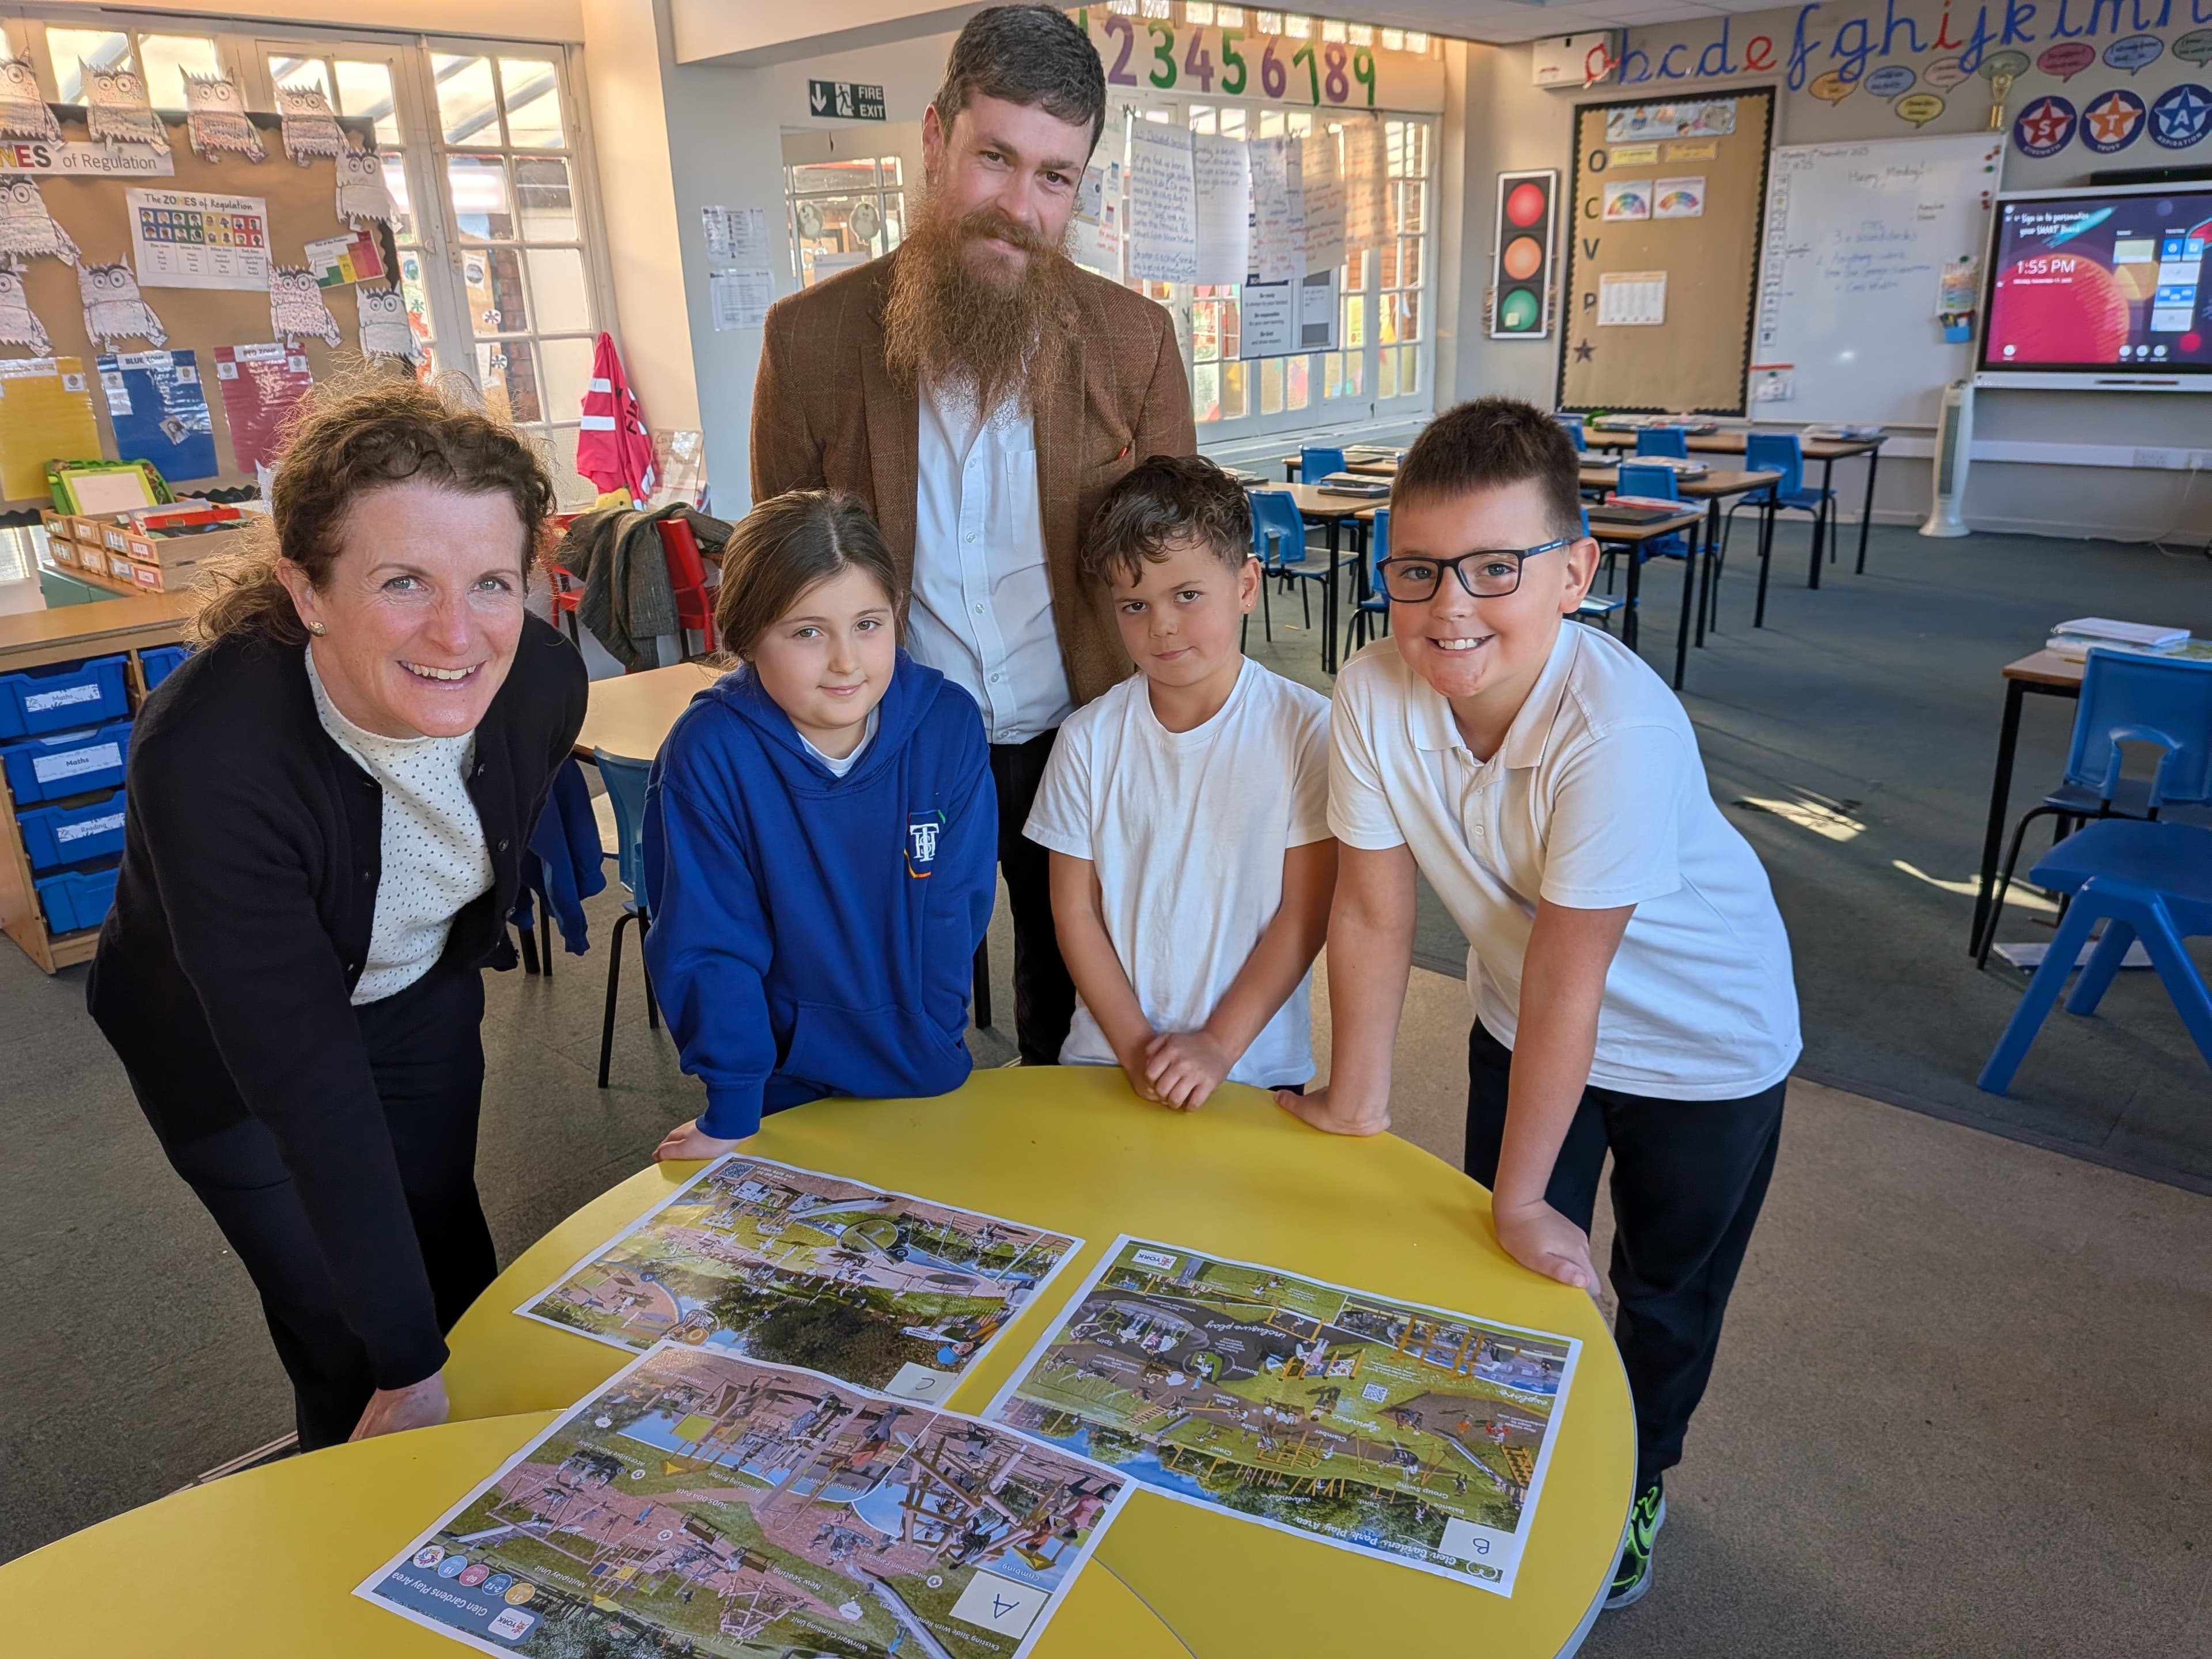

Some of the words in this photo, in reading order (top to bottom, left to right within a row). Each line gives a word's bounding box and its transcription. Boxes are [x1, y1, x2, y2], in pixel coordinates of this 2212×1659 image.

[1105, 15, 1137, 86] 2
[1148, 20, 1177, 89] 3
[1185, 26, 1214, 92] 4
[1222, 29, 1246, 94] 5
[1262, 32, 1287, 99] 6
[1293, 40, 1320, 107] 7
[1325, 42, 1349, 103] 8
[1354, 44, 1375, 106] 9
[858, 86, 882, 100] FIRE
[859, 104, 885, 118] EXIT
[2174, 109, 2190, 125] A
[2038, 120, 2050, 136] S
[2105, 115, 2119, 130] T
[2157, 132, 2203, 147] ASPIRATION
[62, 153, 77, 168] of
[81, 153, 157, 171] Regulation
[1588, 150, 1607, 173] O
[145, 194, 161, 203] The
[163, 195, 196, 206] ZONES
[199, 200, 207, 210] of
[211, 200, 253, 211] Regulation
[1585, 197, 1599, 220] C
[2022, 213, 2035, 225] Sign
[2036, 225, 2059, 235] SMART
[1583, 238, 1600, 261] V
[2017, 260, 2047, 274] 1:55
[2051, 259, 2075, 273] PM
[125, 356, 144, 365] BLUE
[52, 692, 74, 702] Maths
[66, 756, 89, 766] Maths
[81, 822, 107, 833] Reading
[1138, 1253, 1160, 1262] YORK
[1204, 1320, 1234, 1331] play
[1233, 1325, 1286, 1340] inclusive
[1097, 1338, 1114, 1346] Spin
[1233, 1365, 1259, 1376] Bounce
[668, 1372, 703, 1384] Horizontal
[1213, 1392, 1238, 1403] together
[1216, 1398, 1232, 1406] Rock
[1241, 1422, 1259, 1432] Slide
[1314, 1429, 1347, 1443] Clamber
[578, 1440, 594, 1449] Table
[594, 1445, 612, 1455] Picnic
[612, 1450, 645, 1467] Accessible
[675, 1487, 694, 1498] Path
[729, 1477, 761, 1494] Balancing
[824, 1480, 861, 1494] Fireman's
[1395, 1480, 1421, 1494] Swing
[1422, 1488, 1448, 1499] Group
[708, 1497, 728, 1510] SUDS
[1357, 1498, 1380, 1509] Climb
[1434, 1502, 1464, 1515] Balance
[1293, 1516, 1321, 1530] Area
[1323, 1522, 1348, 1538] Play
[1351, 1531, 1378, 1546] Park
[1379, 1539, 1427, 1559] Gardens
[1472, 1538, 1490, 1555] B
[863, 1552, 891, 1567] Carousel
[1430, 1551, 1456, 1566] Glen
[534, 1565, 552, 1577] Unit
[772, 1567, 802, 1583] Seating
[891, 1563, 927, 1580] Integration
[1002, 1563, 1040, 1582] Climbing
[391, 1571, 414, 1586] Area
[552, 1571, 588, 1589] Multiplay
[802, 1579, 821, 1590] New
[413, 1578, 432, 1594] Play
[432, 1588, 467, 1608] Gardens
[466, 1603, 488, 1616] Glen
[993, 1593, 1020, 1620] A
[498, 1616, 517, 1628] YORK
[791, 1616, 806, 1627] Unit
[934, 1623, 951, 1633] With
[806, 1622, 837, 1638] Climbing
[951, 1628, 970, 1641] Slide
[837, 1634, 868, 1652] WirrWarr
[970, 1635, 1000, 1651] Existing
